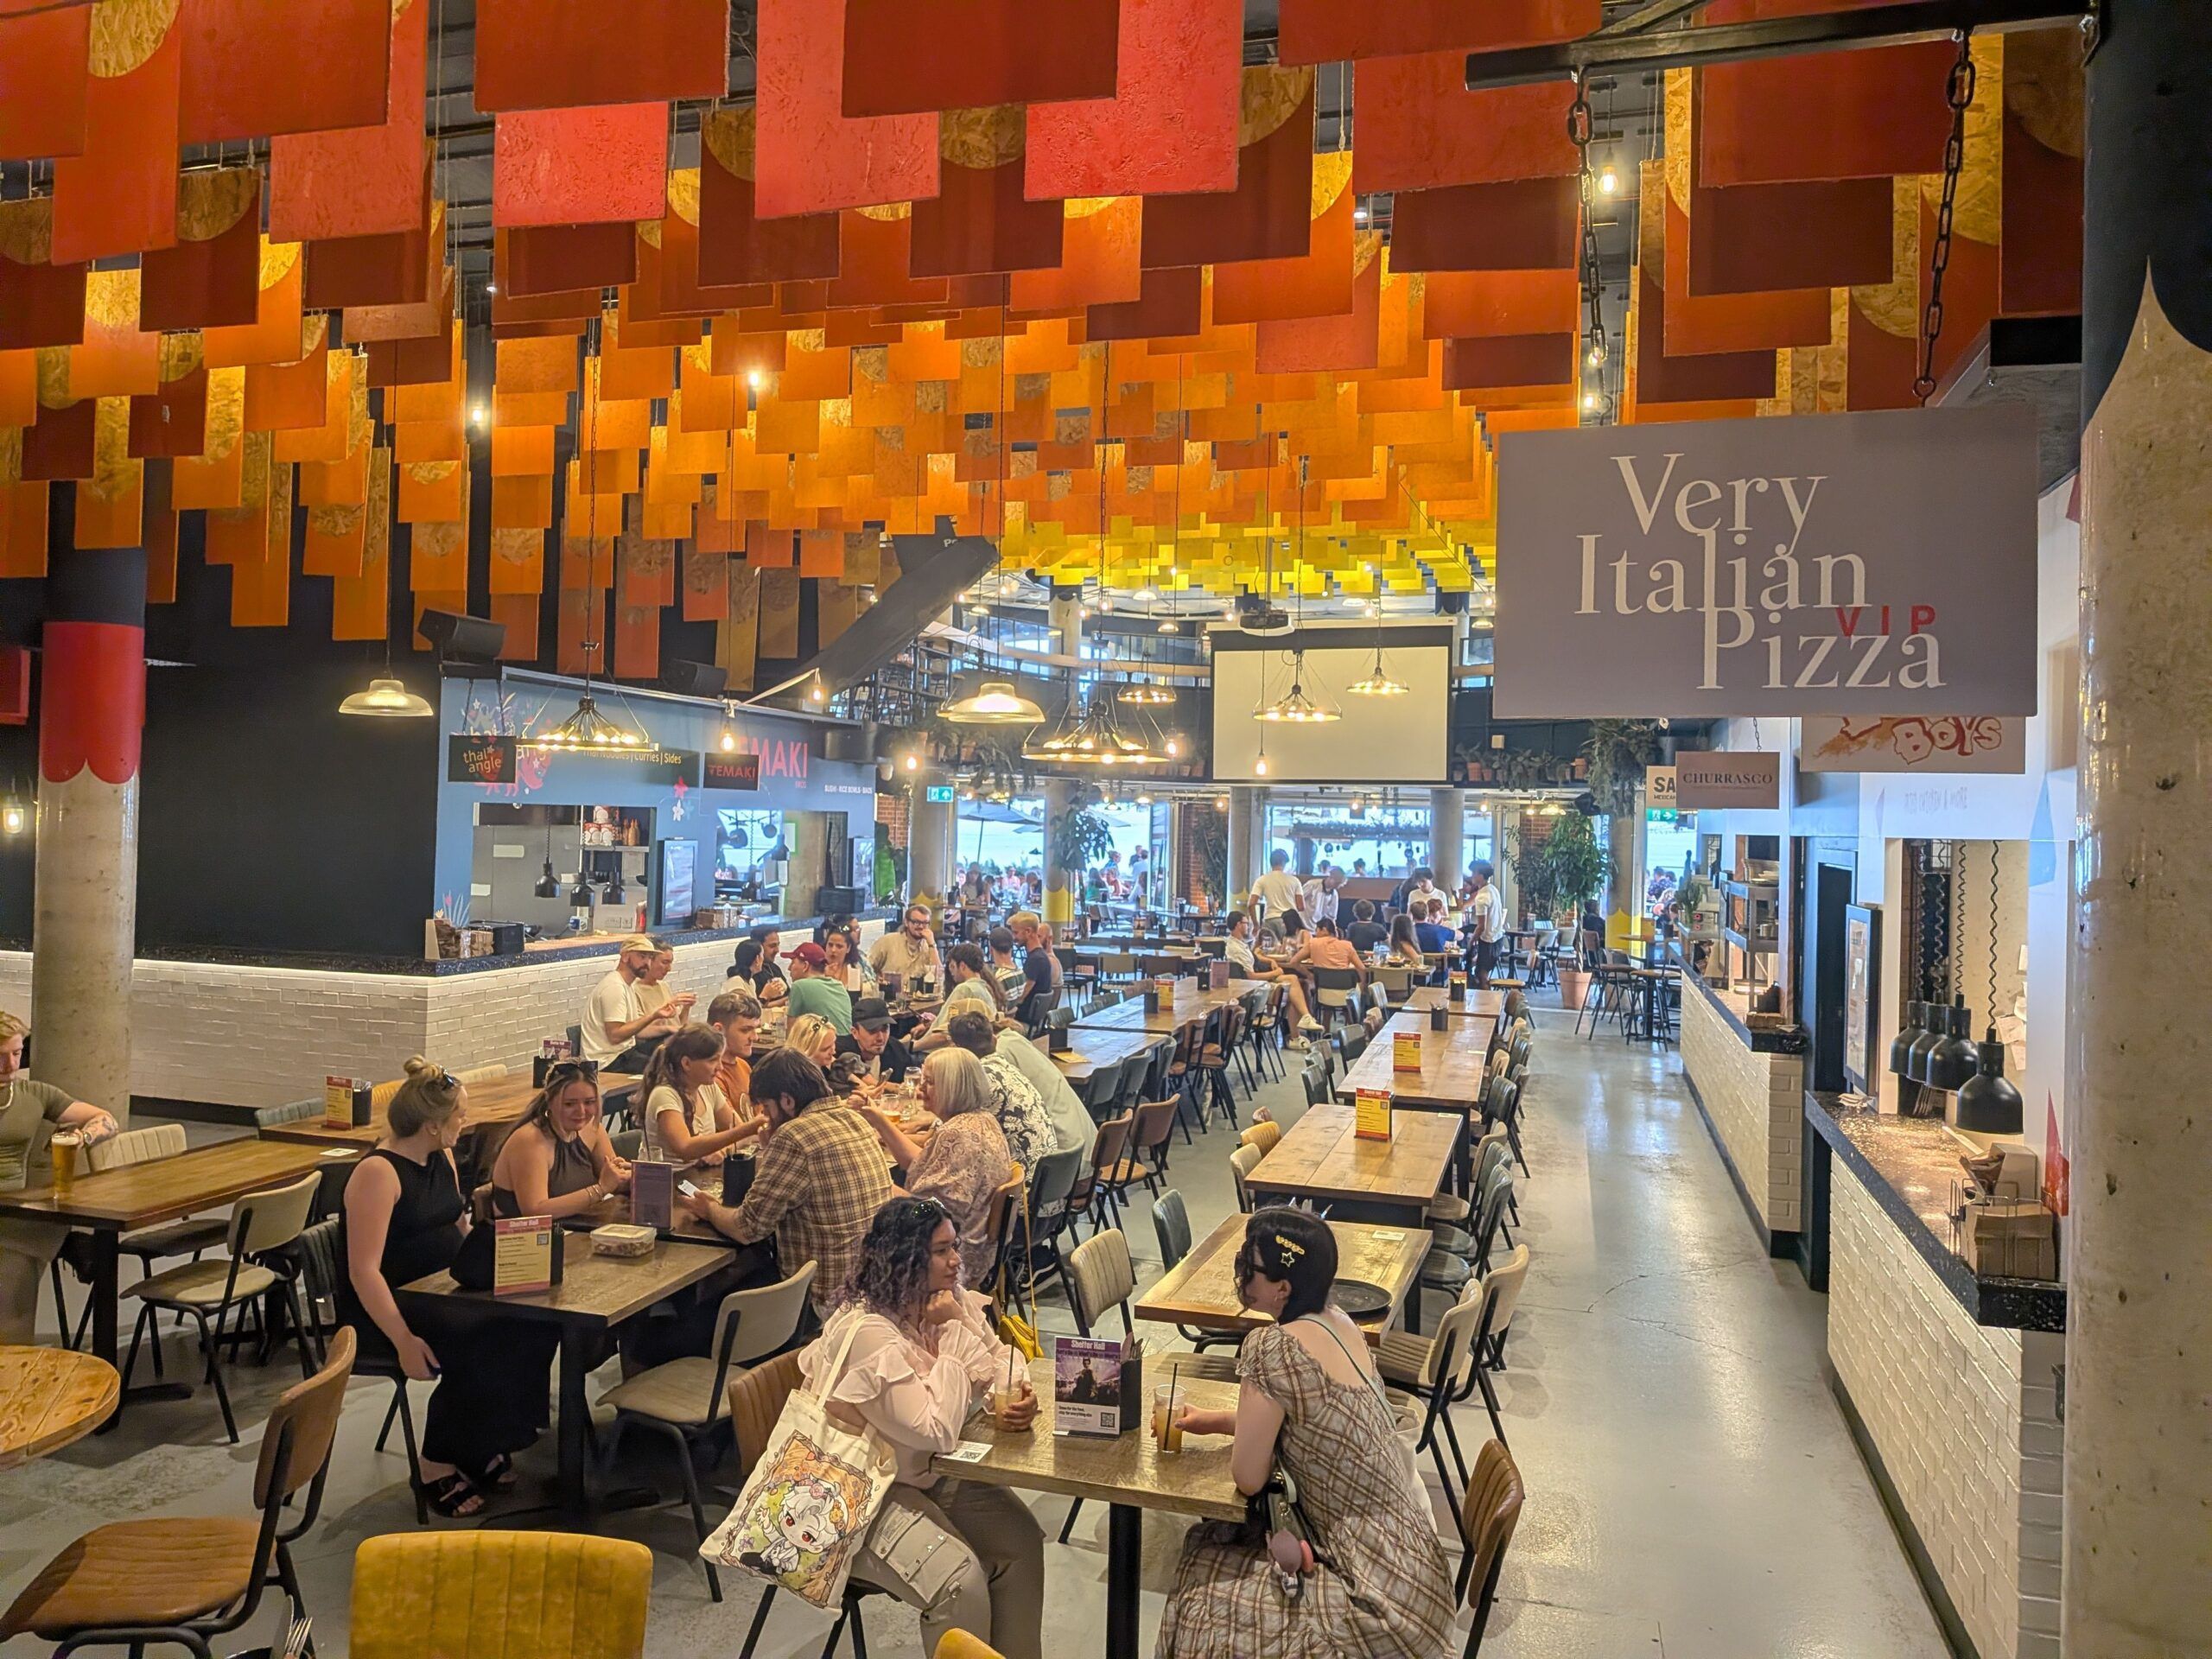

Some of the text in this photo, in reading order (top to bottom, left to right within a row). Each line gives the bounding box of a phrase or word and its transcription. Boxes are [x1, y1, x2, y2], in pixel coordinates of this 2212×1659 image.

[1610, 453, 1830, 556] Very
[1573, 529, 1872, 615] Italian
[1836, 605, 1936, 637] VIP
[1695, 605, 1946, 690] Pizza
[1891, 716, 2002, 765] BOYS
[468, 758, 501, 773] angle
[664, 753, 682, 765] Sides
[708, 765, 756, 778] TEMAKI
[1682, 772, 1773, 785] CHURRASCO
[1071, 1339, 1106, 1351] Shelter Hall
